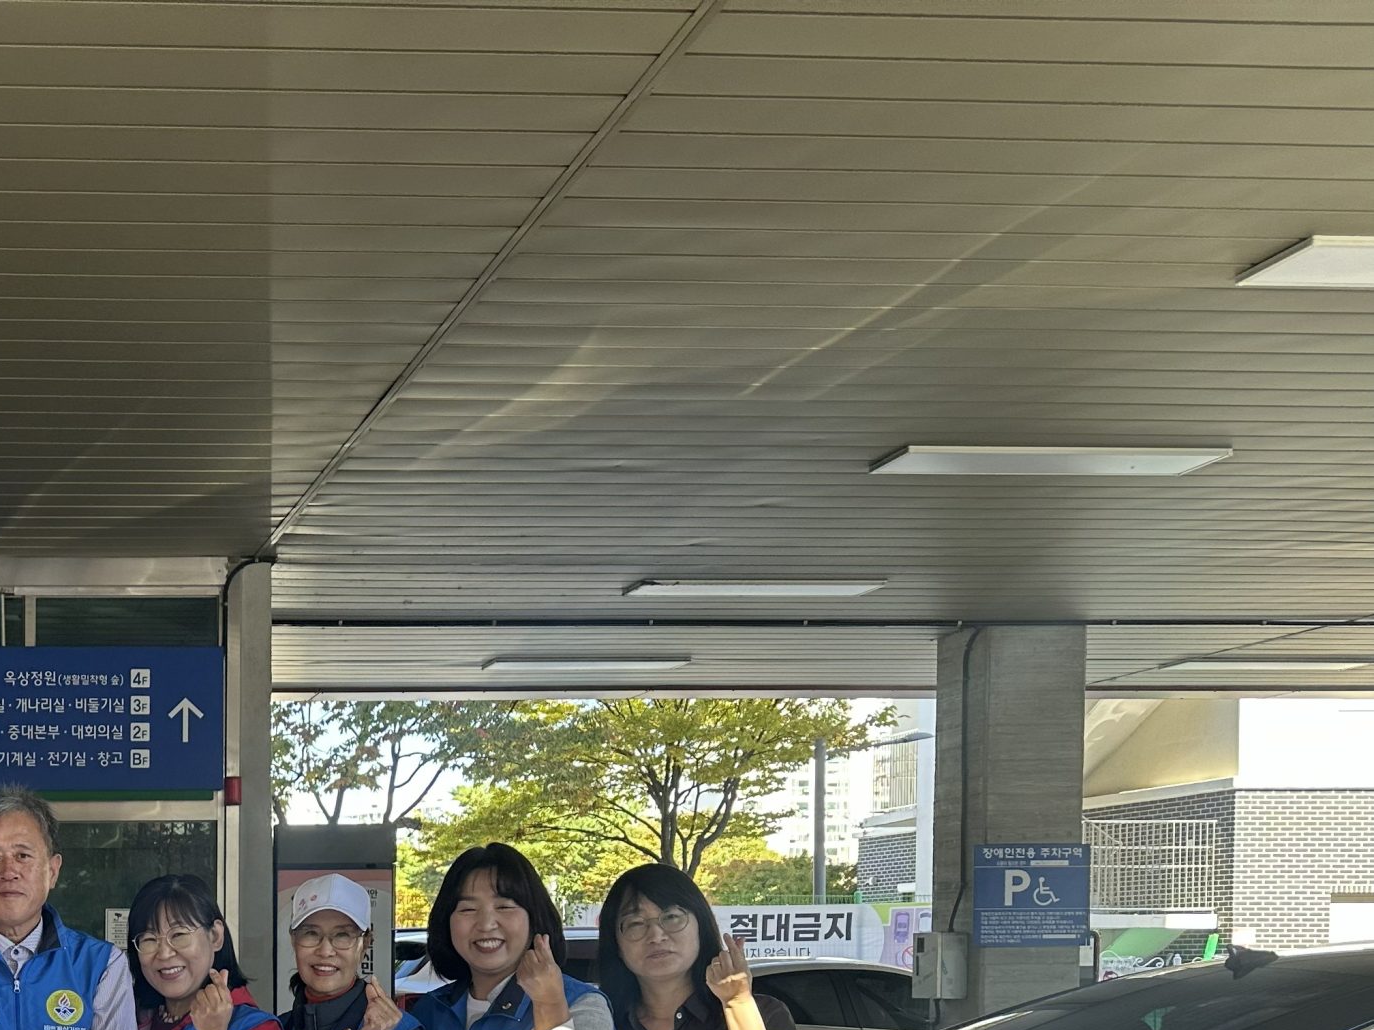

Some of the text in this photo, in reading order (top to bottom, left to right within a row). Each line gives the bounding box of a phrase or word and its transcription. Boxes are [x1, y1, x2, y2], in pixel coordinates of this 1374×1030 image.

[133, 672, 147, 685] 4F
[16, 698, 64, 713] 개나리실
[76, 698, 124, 713] 비둘기실
[133, 699, 147, 712] 3F
[8, 725, 60, 740] 중대본부
[72, 725, 123, 740] 대회의실
[133, 726, 147, 739] 2F
[48, 752, 86, 767] 전기실
[98, 752, 123, 767] 창고
[133, 753, 147, 766] BF
[983, 847, 1082, 858] 장애인전용 주차구역
[1005, 870, 1031, 906] P
[730, 912, 853, 942] 절대금지
